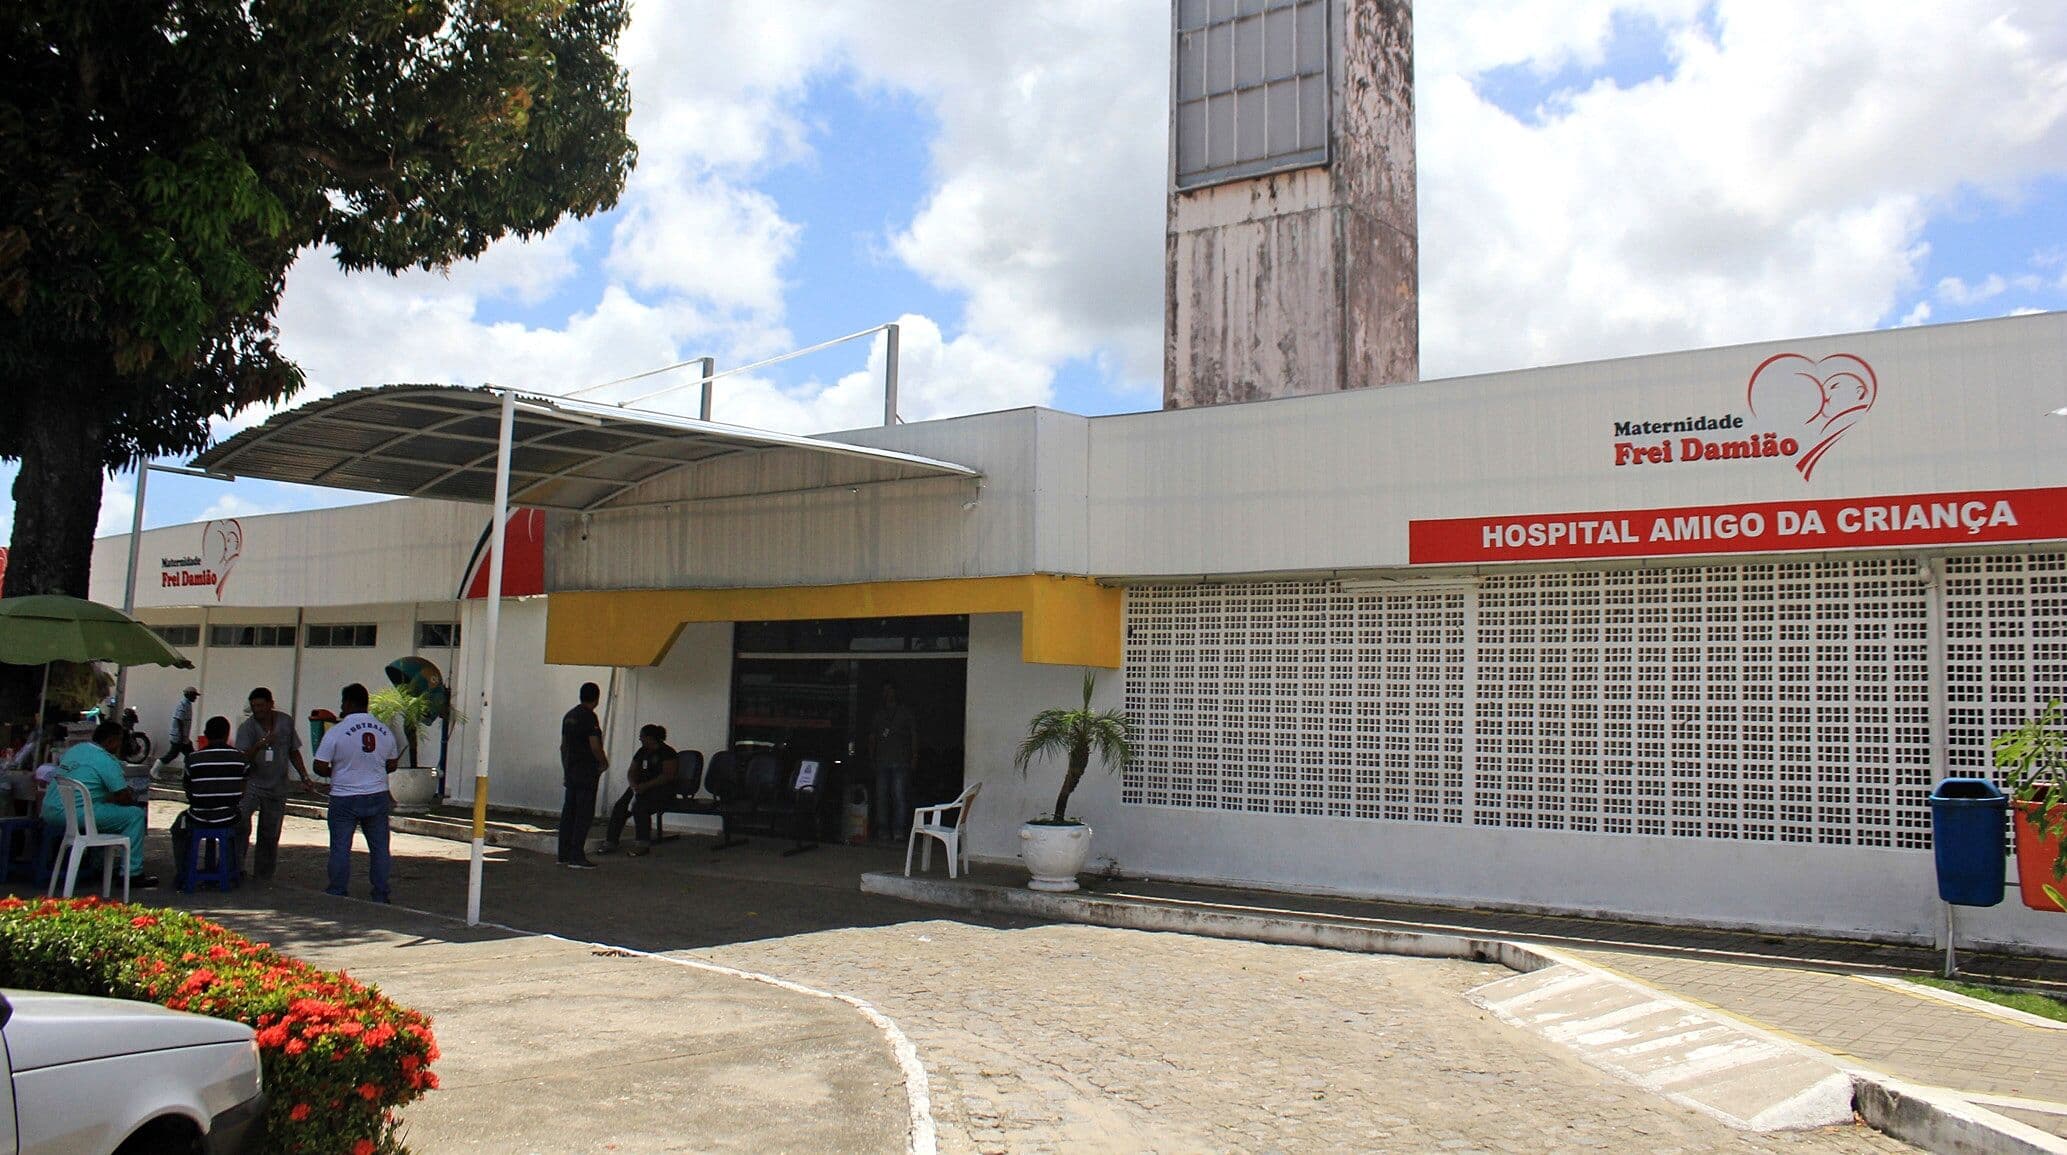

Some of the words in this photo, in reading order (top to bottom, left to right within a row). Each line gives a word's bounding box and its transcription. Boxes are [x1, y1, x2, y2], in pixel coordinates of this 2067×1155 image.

[1614, 414, 1743, 437] Maternidade
[1614, 440, 1673, 466] Frei
[1680, 432, 1799, 462] Damião
[1482, 519, 1640, 548] HOSPITAL
[1649, 512, 1765, 542] AMIGO
[1776, 509, 1826, 536] DA
[1836, 500, 2018, 535] CRIANÇA
[161, 556, 201, 568] Maternidade
[161, 571, 180, 588] Frei
[182, 569, 217, 587] Damião
[345, 722, 387, 736] FOOTBALL
[361, 731, 376, 753] 9
